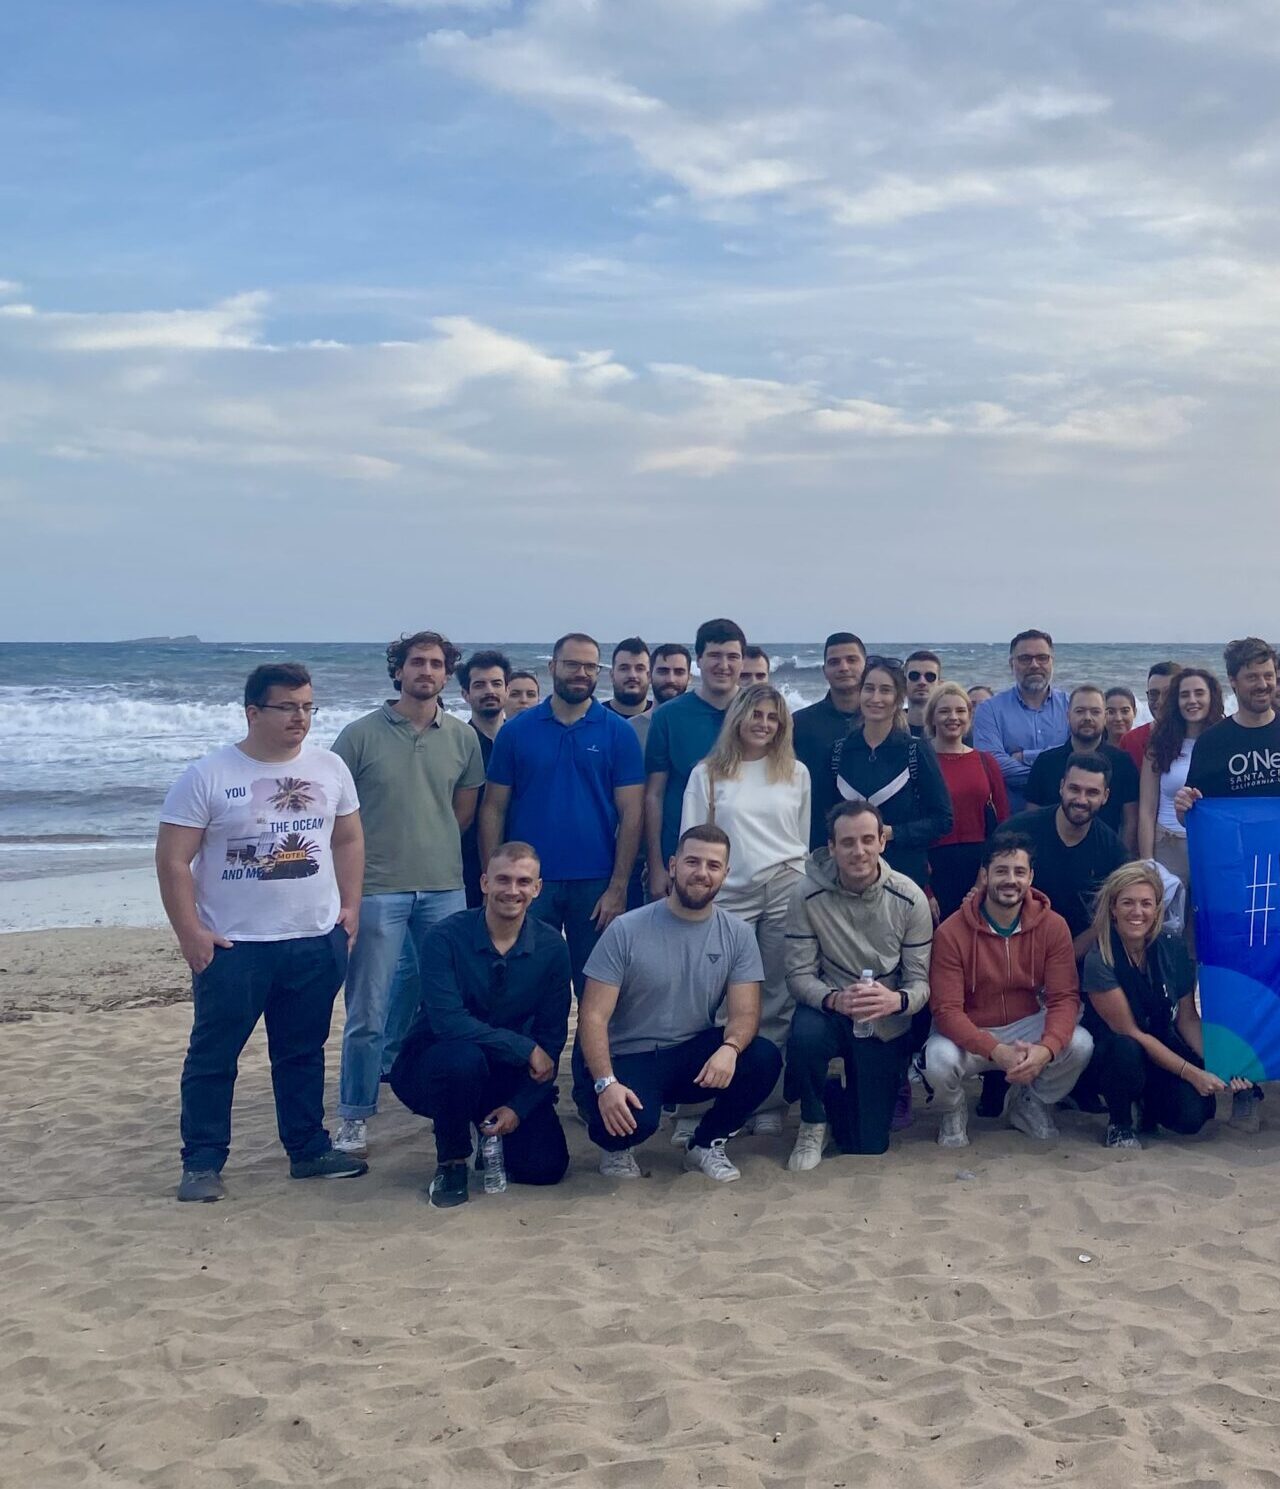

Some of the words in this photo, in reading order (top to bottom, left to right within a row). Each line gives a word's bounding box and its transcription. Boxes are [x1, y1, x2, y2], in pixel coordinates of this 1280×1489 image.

[1230, 771, 1264, 784] SANTA
[225, 787, 246, 799] YOU
[270, 821, 290, 833] THE
[292, 818, 324, 832] OCEAN
[278, 852, 305, 860] MOTEL
[222, 869, 243, 880] AND
[245, 867, 264, 879] ME
